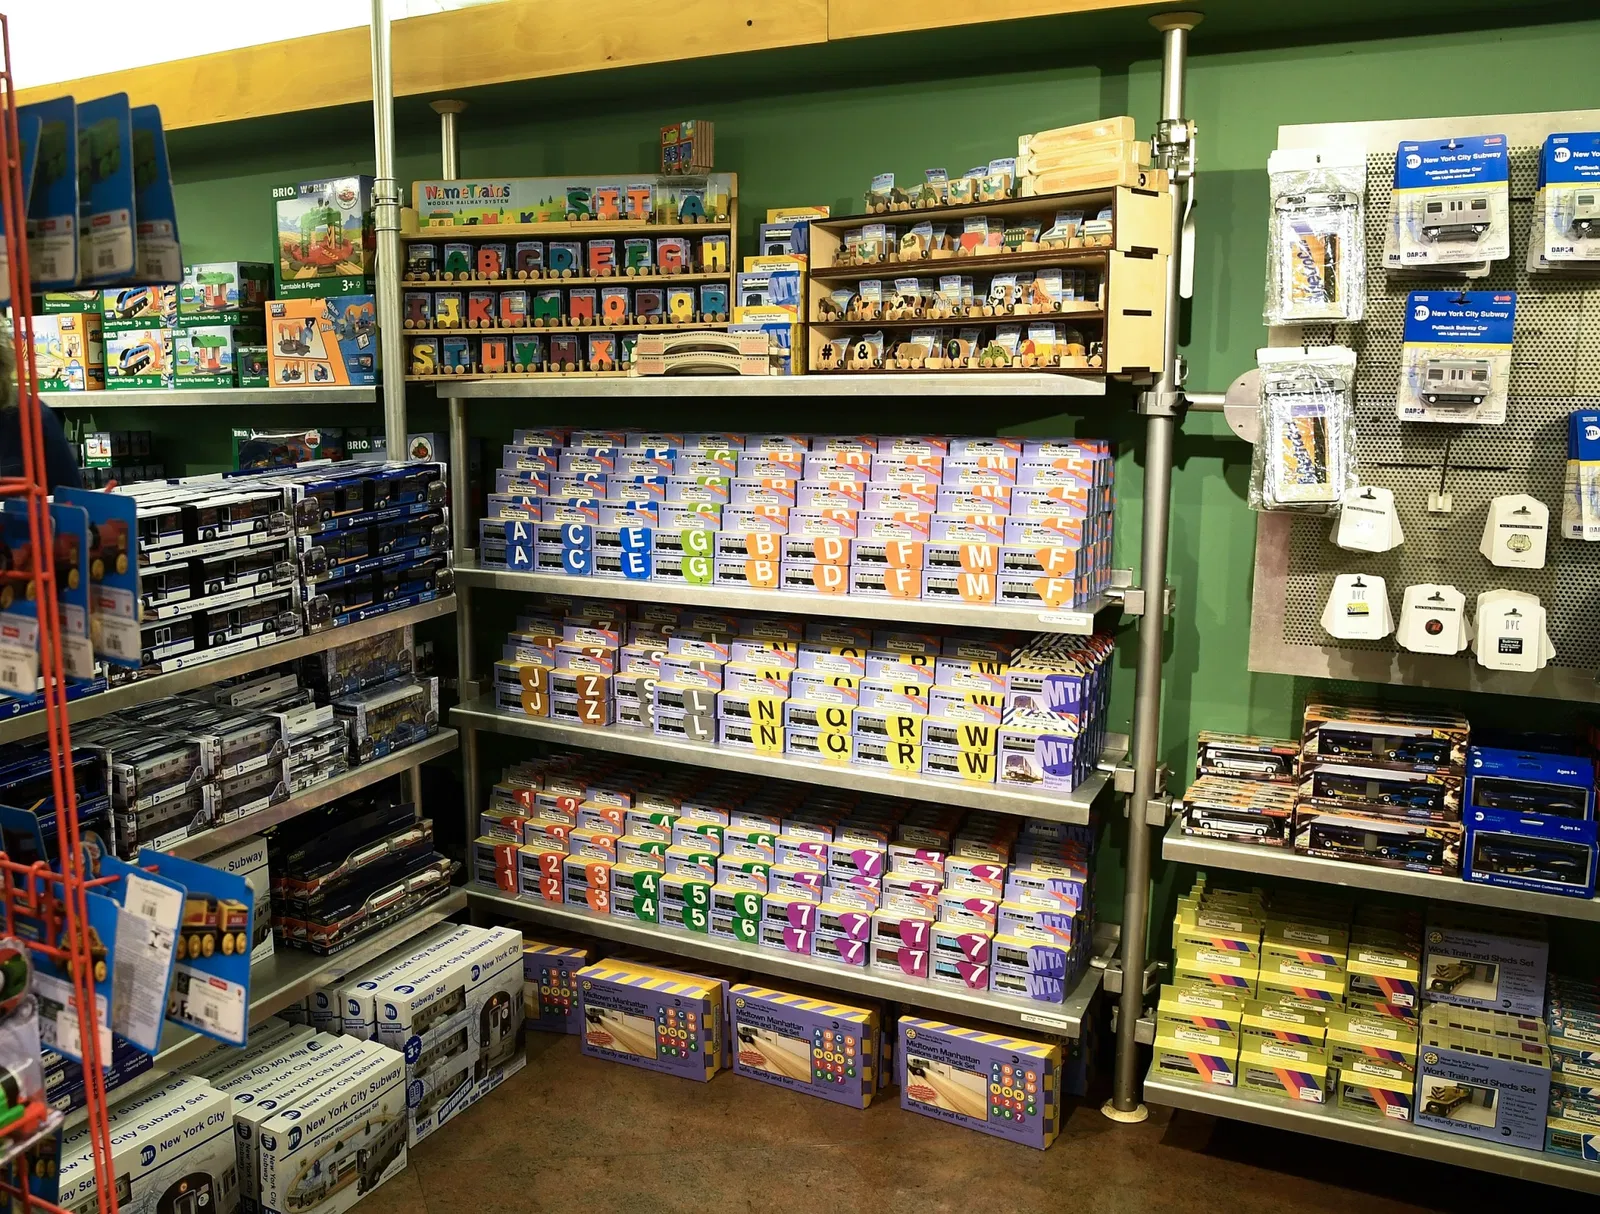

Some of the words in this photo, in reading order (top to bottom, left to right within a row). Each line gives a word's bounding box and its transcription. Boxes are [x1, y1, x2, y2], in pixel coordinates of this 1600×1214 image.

[1473, 152, 1501, 160] Subway
[425, 184, 510, 199] NameTrains
[567, 192, 589, 214] S
[446, 251, 468, 272] A
[478, 250, 499, 273] B
[590, 247, 612, 269] E
[629, 246, 648, 268] F
[658, 245, 681, 267] G
[703, 242, 724, 265] H
[342, 280, 354, 291] 3+
[437, 299, 459, 321] J
[469, 298, 492, 321] K
[502, 298, 524, 320] L
[534, 297, 559, 319] M
[571, 297, 593, 318] N
[638, 294, 659, 316] P
[703, 292, 724, 314] R
[513, 521, 527, 540] A
[568, 524, 583, 544] C
[629, 528, 644, 547] E
[689, 530, 707, 550] G
[757, 534, 773, 555] B
[825, 538, 842, 560] D
[898, 542, 912, 563] F
[515, 546, 528, 564] A
[569, 550, 585, 568] C
[629, 554, 644, 573] E
[968, 545, 991, 567] M
[1049, 548, 1067, 569] F
[690, 557, 707, 576] G
[756, 560, 772, 581] B
[824, 565, 841, 585] D
[897, 570, 911, 590] F
[966, 574, 990, 596] M
[1046, 578, 1065, 598] F
[529, 669, 540, 687] J
[584, 676, 599, 695] Z
[530, 693, 541, 710] J
[585, 701, 600, 719] Z
[692, 690, 706, 710] L
[758, 700, 774, 719] N
[693, 715, 707, 734] L
[826, 708, 848, 726] Q
[898, 717, 914, 737] R
[760, 726, 777, 745] N
[826, 734, 848, 752] Q
[966, 726, 989, 746] W
[898, 744, 914, 764] R
[966, 753, 988, 773] W
[228, 851, 263, 871] Subway
[503, 847, 512, 865] 1
[549, 856, 559, 872] 2
[505, 869, 513, 886] 1
[594, 866, 607, 884] 3
[642, 875, 655, 893] 4
[548, 879, 560, 895] 2
[692, 886, 705, 904] 5
[595, 889, 608, 906] 3
[642, 898, 654, 915] 4
[744, 895, 758, 914] 6
[692, 909, 705, 927] 5
[798, 905, 810, 925] 7
[852, 914, 866, 934] 7
[742, 919, 755, 937] 6
[794, 928, 806, 948] 7
[912, 923, 925, 942] 7
[847, 940, 862, 959] 7
[971, 936, 986, 956] 7
[482, 960, 494, 971] New
[495, 951, 507, 963] York
[508, 945, 519, 955] City
[910, 950, 924, 969] 7
[1028, 948, 1063, 971] MTA
[969, 964, 983, 982] 7
[1028, 976, 1063, 997] MTA
[410, 990, 434, 1010] Subway
[436, 985, 446, 995] Set
[736, 1009, 766, 1021] Midtown
[767, 1016, 804, 1031] Manhattan
[906, 1039, 938, 1054] Midtown
[940, 1047, 980, 1065] Manhattan
[906, 1047, 931, 1058] Stations
[933, 1054, 944, 1062] and
[945, 1056, 963, 1067] Track
[964, 1061, 976, 1070] Set
[1423, 1066, 1445, 1077] Work
[1448, 1071, 1469, 1081] Train
[1471, 1076, 1488, 1084] and
[1490, 1079, 1518, 1090] Sheds
[1521, 1085, 1536, 1094] Set
[306, 1118, 326, 1134] New
[328, 1102, 348, 1119] York
[351, 1090, 367, 1105] City
[370, 1067, 401, 1092] Subway
[922, 1104, 942, 1116] sturdy
[111, 1131, 137, 1145] City
[137, 1105, 186, 1130] Subway
[185, 1092, 208, 1105] Set
[160, 1138, 181, 1152] New
[183, 1122, 204, 1138] York
[207, 1112, 225, 1125] City
